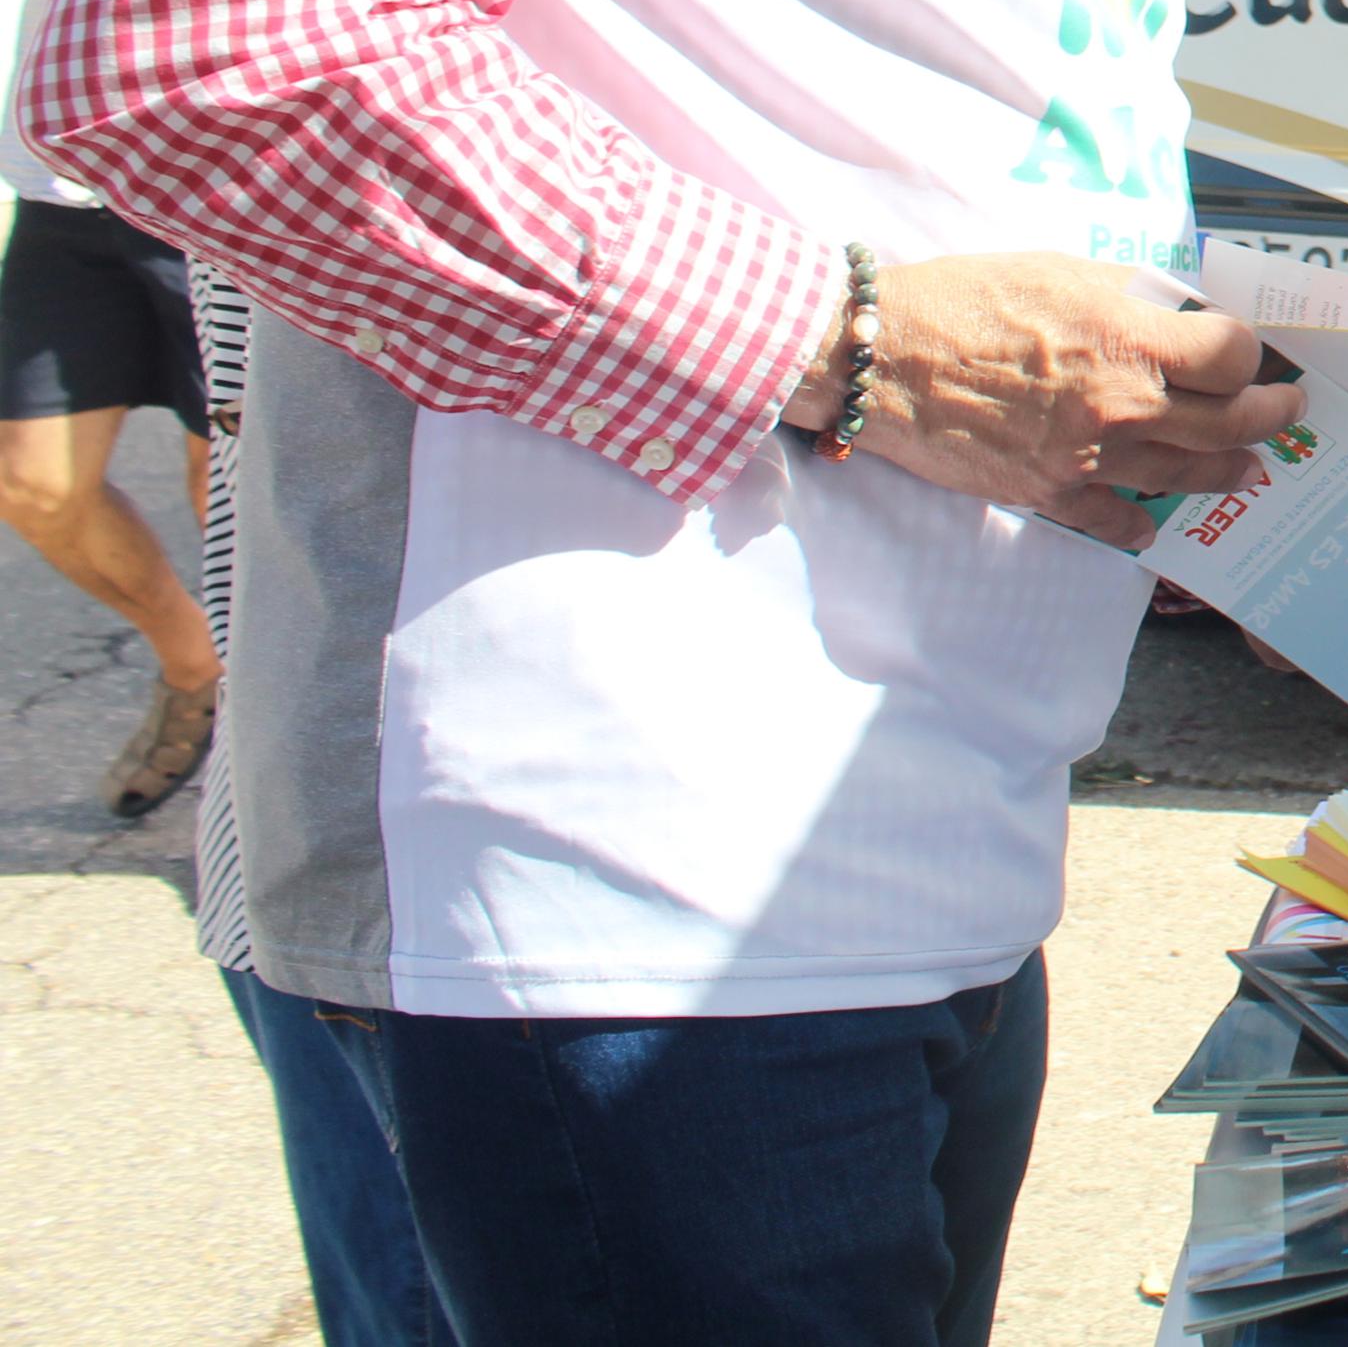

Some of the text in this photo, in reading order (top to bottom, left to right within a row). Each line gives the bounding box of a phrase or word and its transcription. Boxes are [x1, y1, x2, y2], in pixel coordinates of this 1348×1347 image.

[1009, 95, 1188, 206] Alc
[1089, 223, 1199, 273] Palenci
[1286, 476, 1331, 519] DONANTE
[1271, 518, 1288, 534] DE
[1309, 535, 1344, 569] ES
[1241, 567, 1311, 630] AMAR
